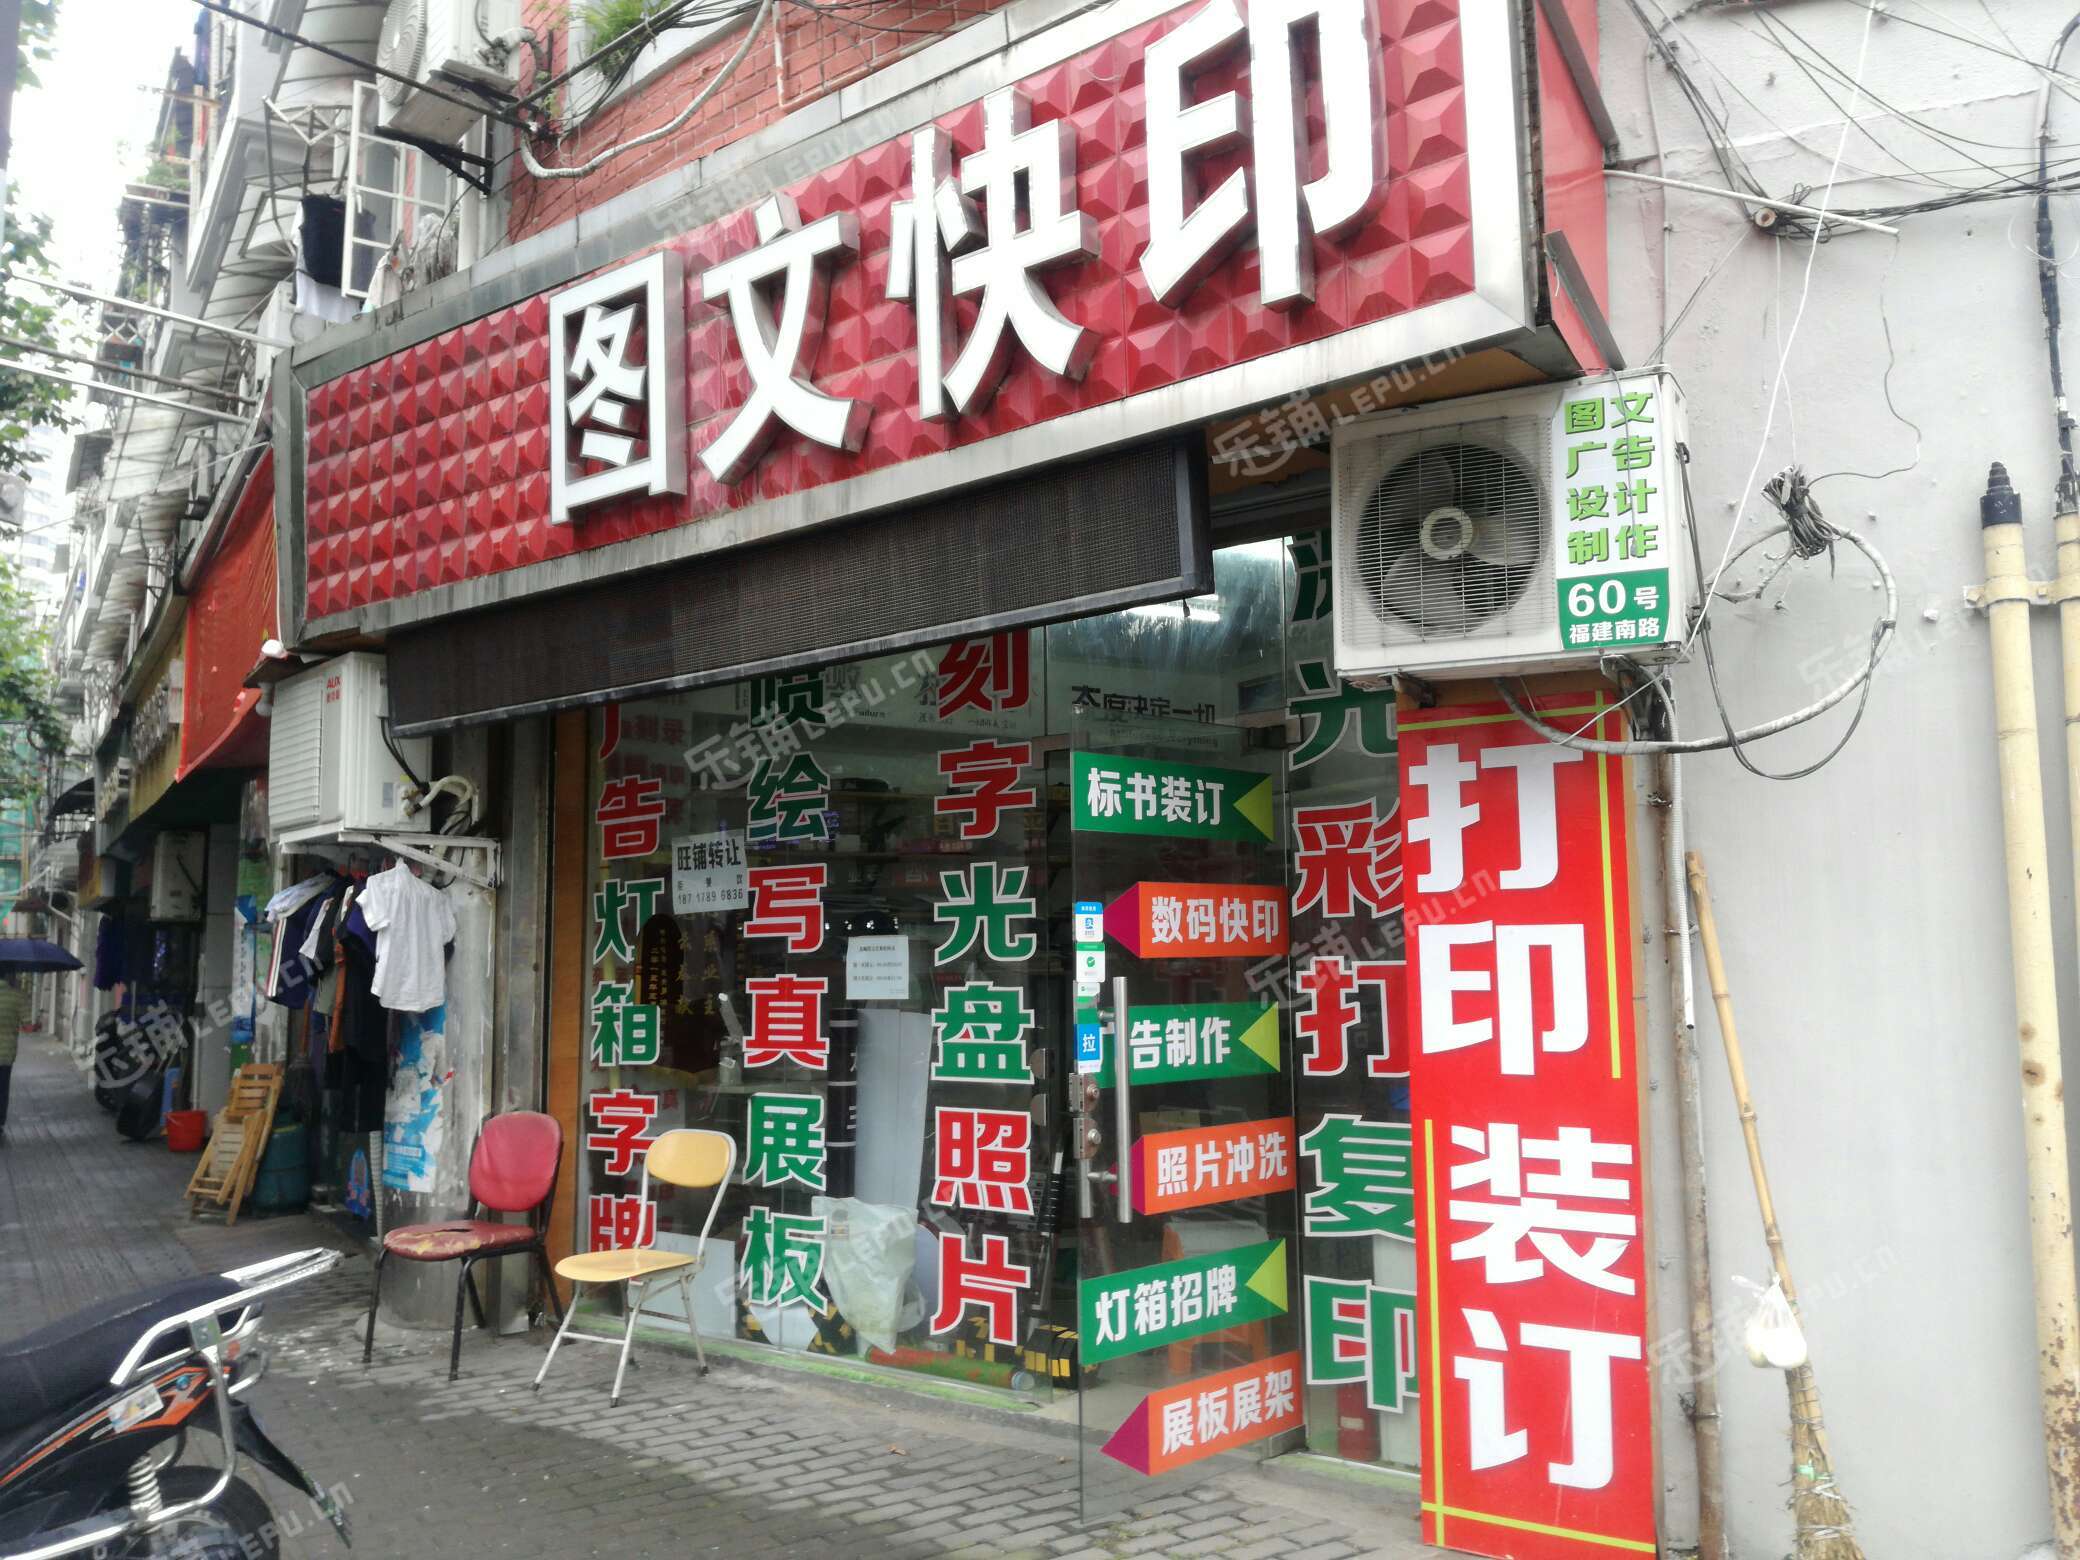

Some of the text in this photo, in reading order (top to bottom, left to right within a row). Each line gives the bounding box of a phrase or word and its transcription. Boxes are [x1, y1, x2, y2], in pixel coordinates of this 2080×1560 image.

[549, 0, 1388, 525] 图文快印
[1563, 391, 1655, 436] 图文
[1565, 434, 1656, 479] 广告
[1565, 478, 1658, 522] 设计
[1567, 524, 1659, 566] 制作
[1567, 579, 1660, 618] 60号
[1568, 618, 1661, 645] 福建南路
[1087, 767, 1225, 826] 标书装订
[677, 838, 742, 871] 旺铺转让
[1150, 894, 1280, 945] 数码快印
[1082, 1033, 1097, 1053] 拉
[1407, 742, 1643, 1490] 打印装订
[1156, 1131, 1288, 1198] 照片冲洗
[1094, 1264, 1238, 1347] 灯箱招牌
[1161, 1368, 1295, 1457] 展板展架
